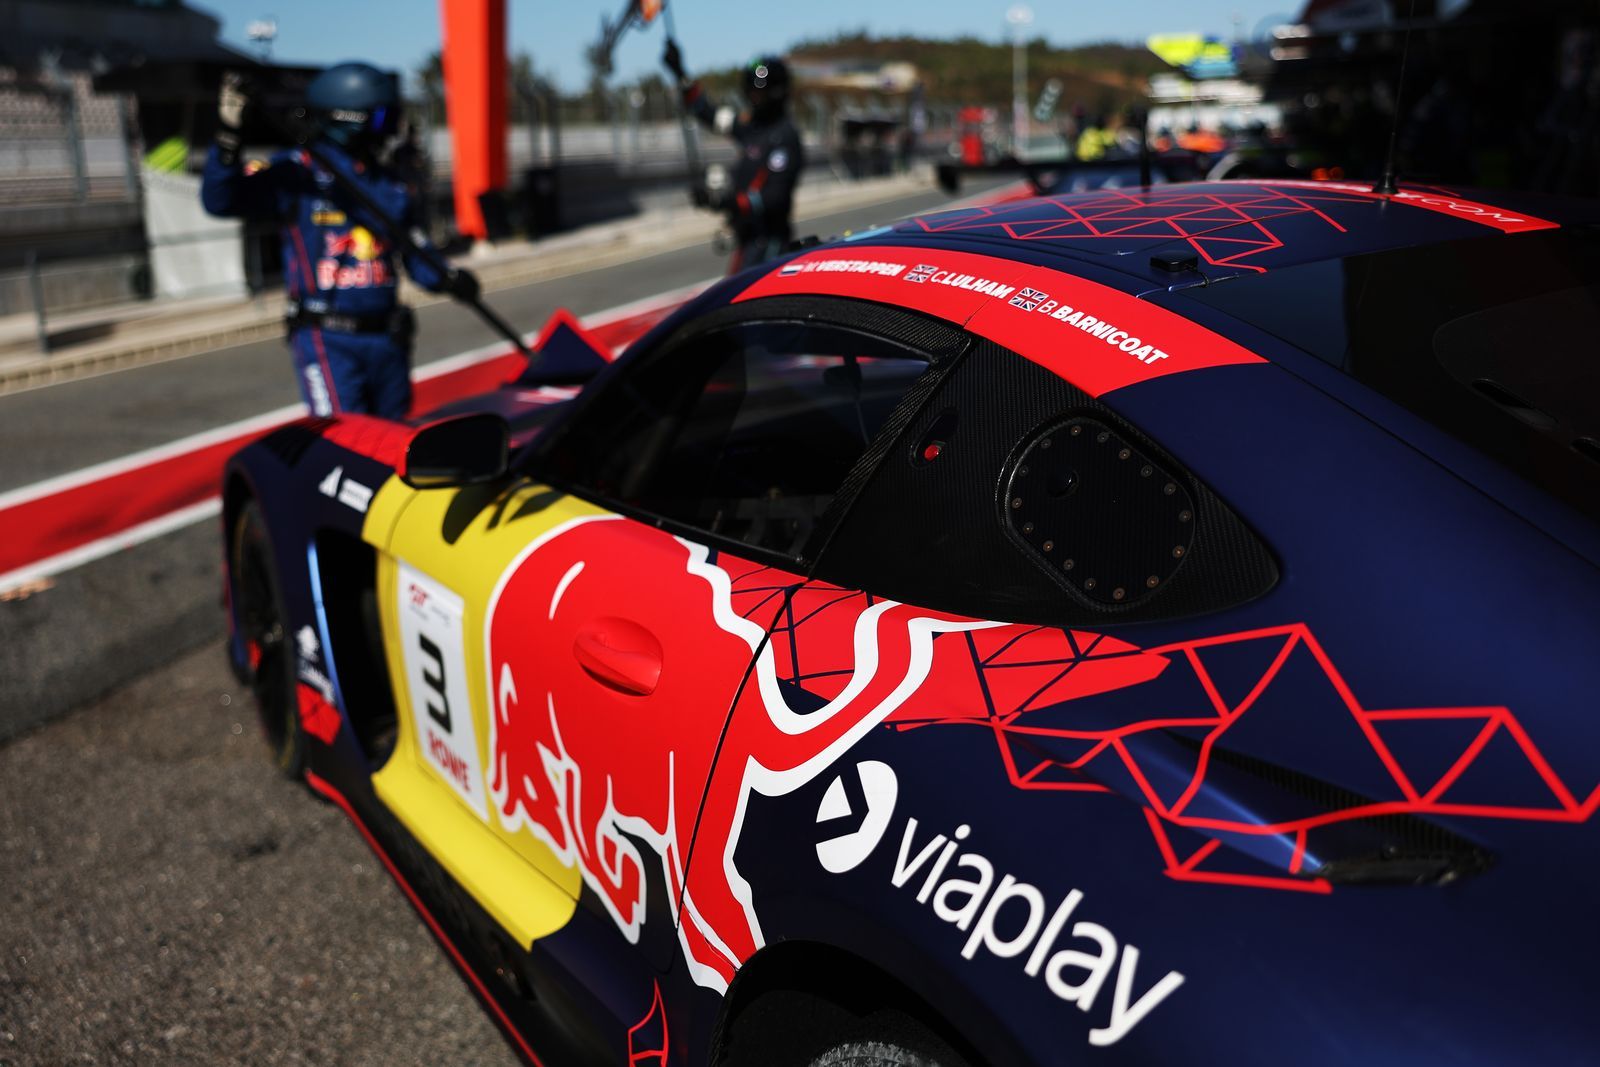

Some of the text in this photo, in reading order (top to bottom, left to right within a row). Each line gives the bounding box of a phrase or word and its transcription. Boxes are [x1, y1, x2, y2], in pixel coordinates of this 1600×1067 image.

[930, 270, 1016, 300] C.LULHAM
[1037, 299, 1170, 365] B.BARNICOAT
[418, 632, 453, 735] 3
[890, 816, 1186, 1046] viaplay
